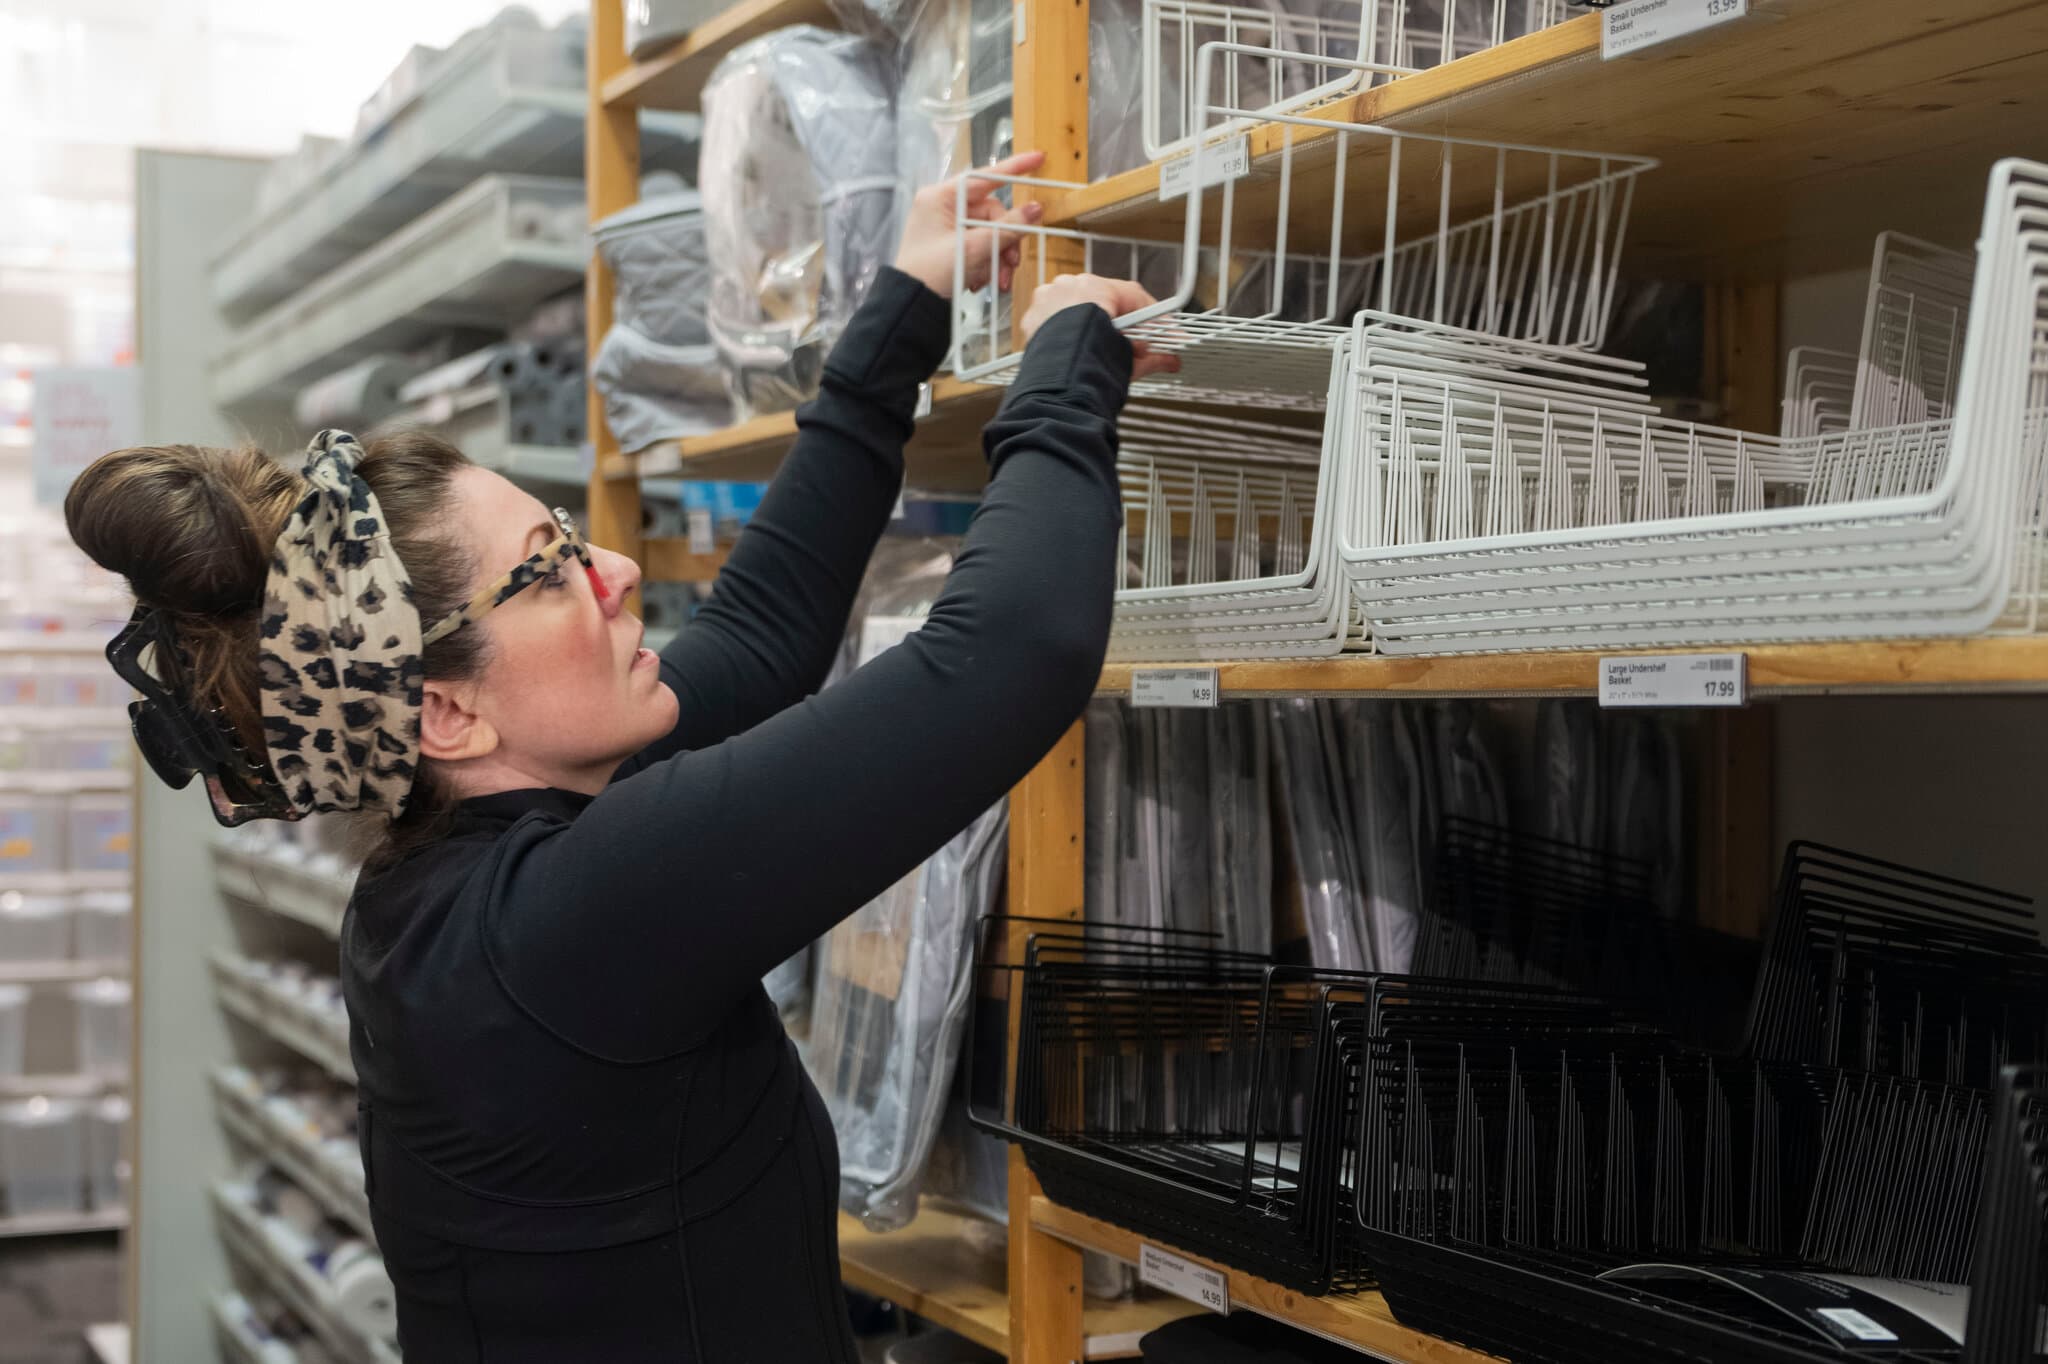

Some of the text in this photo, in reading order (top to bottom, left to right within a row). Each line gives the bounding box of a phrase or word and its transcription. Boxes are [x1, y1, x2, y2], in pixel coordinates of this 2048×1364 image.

[1707, 0, 1738, 16] 13.99
[1610, 10, 1629, 24] Small
[1610, 20, 1634, 35] Basket
[1608, 663, 1667, 676] Large Undershelf
[1608, 675, 1632, 685] Basket
[1192, 688, 1211, 700] 14.99
[1705, 681, 1735, 697] 17.99
[1202, 1288, 1221, 1306] 14.99
